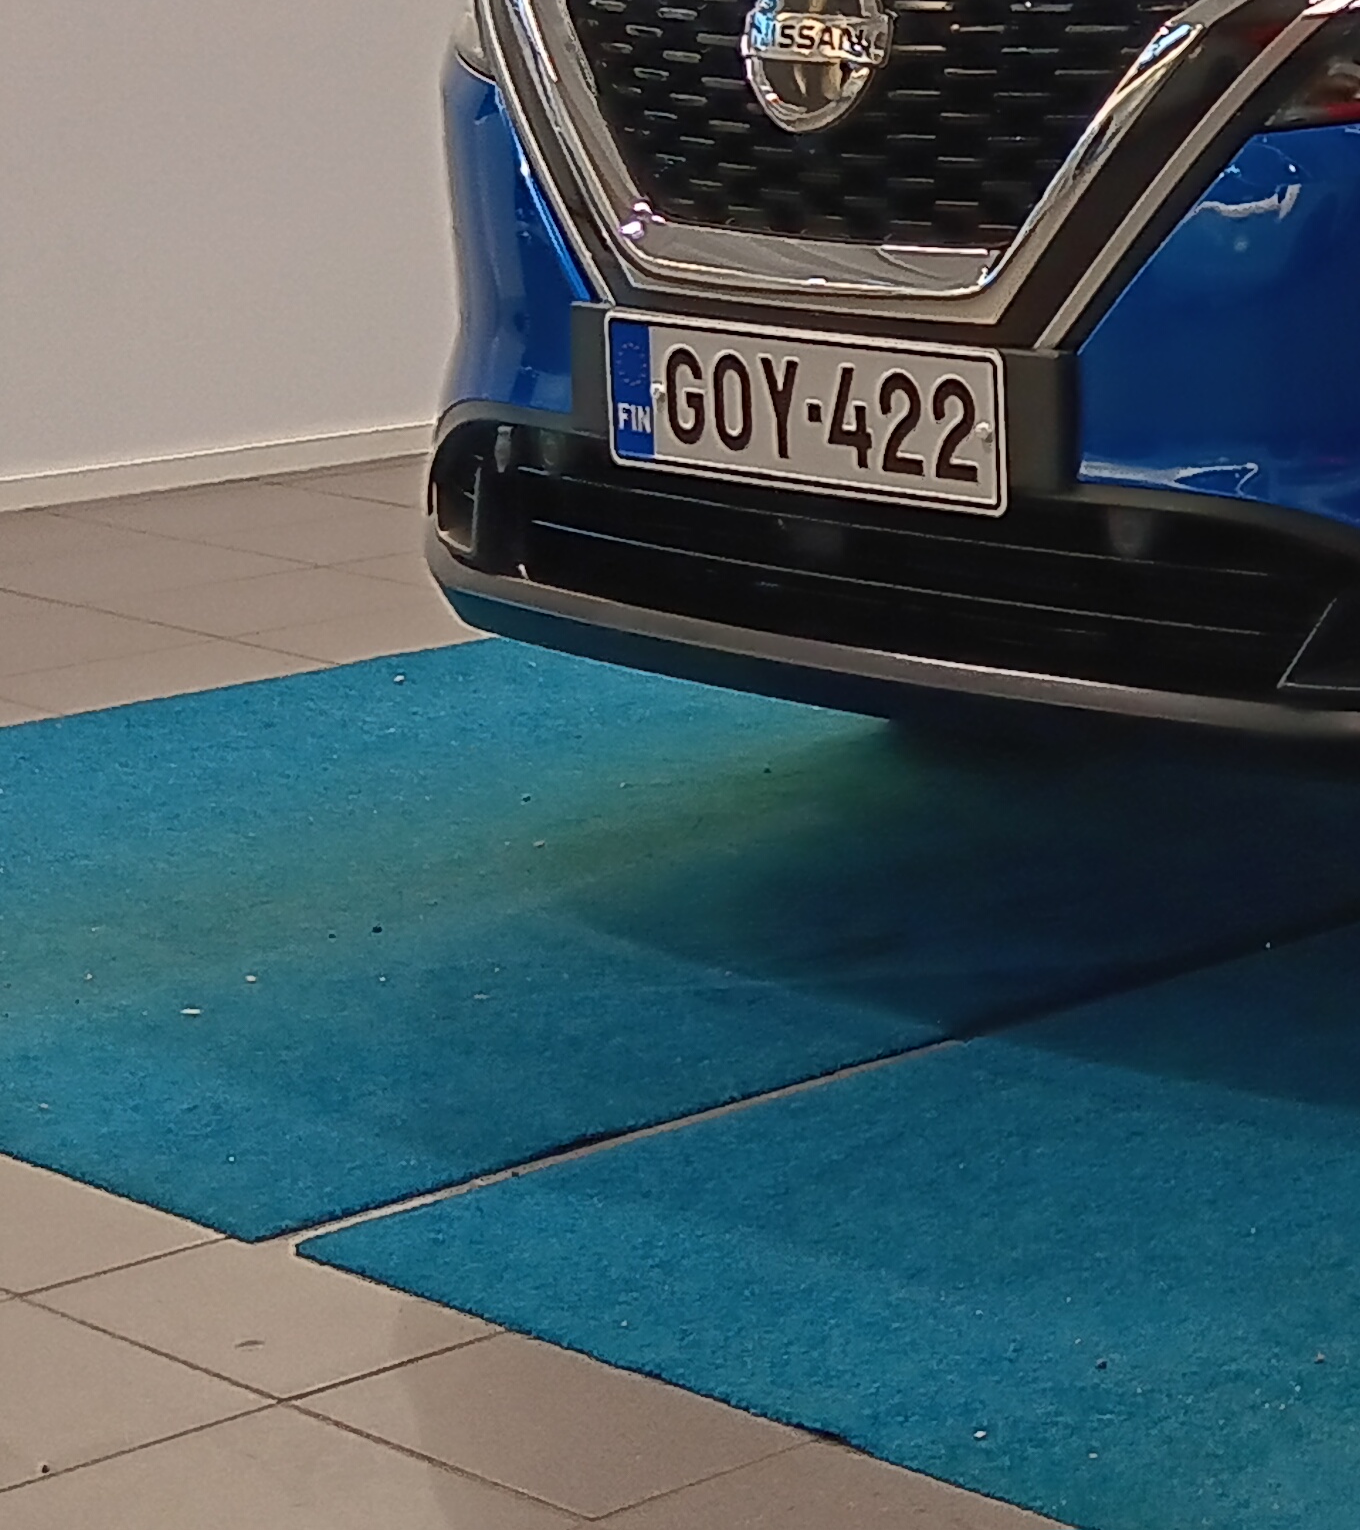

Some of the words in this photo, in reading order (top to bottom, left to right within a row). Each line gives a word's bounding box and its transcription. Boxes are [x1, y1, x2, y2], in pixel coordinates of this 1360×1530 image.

[752, 22, 866, 53] NISSAN
[616, 401, 652, 434] FIN
[665, 345, 979, 484] GOY-422
